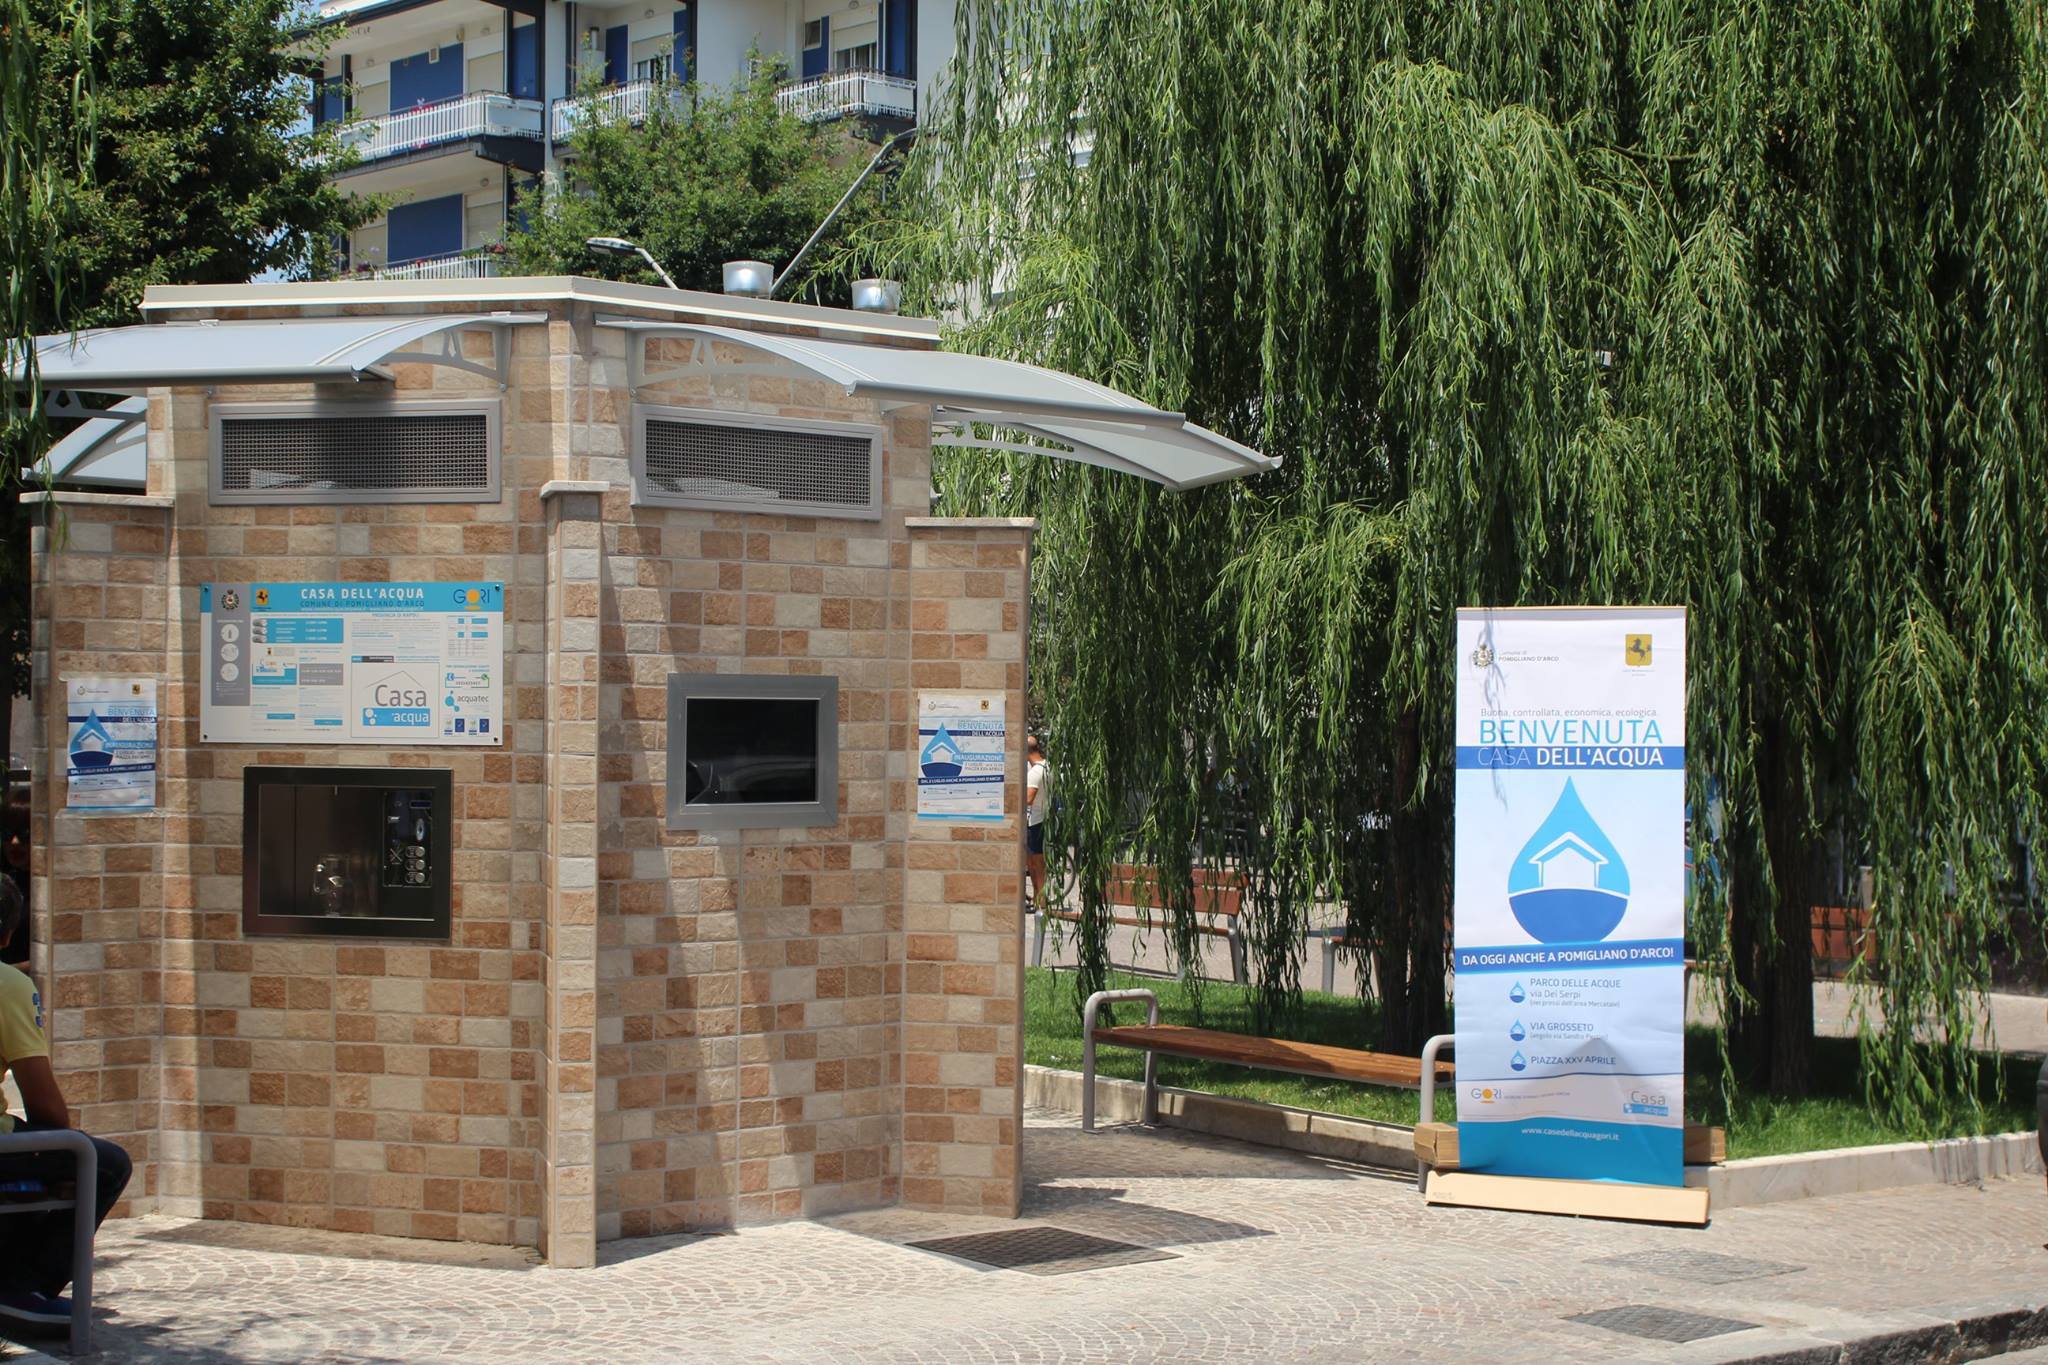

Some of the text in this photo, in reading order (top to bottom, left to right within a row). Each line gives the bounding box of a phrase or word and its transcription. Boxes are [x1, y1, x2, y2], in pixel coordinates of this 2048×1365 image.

[301, 588, 424, 600] CASA DELL'ACQUA
[375, 684, 427, 707] Casa
[1512, 708, 1563, 717] controllata,
[1564, 708, 1613, 717] economica,
[1480, 719, 1663, 744] BENVENUTA
[1477, 747, 1664, 767] CASA DELL'ACQUA
[1462, 947, 1674, 966] DA OGGI ANCHE A POMIGLIANO D'ARCO!
[1530, 978, 1621, 988] PARCO DELLE ACQUE
[1530, 990, 1580, 1000] via Dei Serpi
[1530, 1022, 1594, 1031] VIA GROSSETO
[1531, 1056, 1564, 1064] PIAZZA
[1585, 1056, 1616, 1065] APRILE
[1631, 1090, 1666, 1105] Casa
[1521, 1127, 1620, 1141] www.casedellacquagori.it
